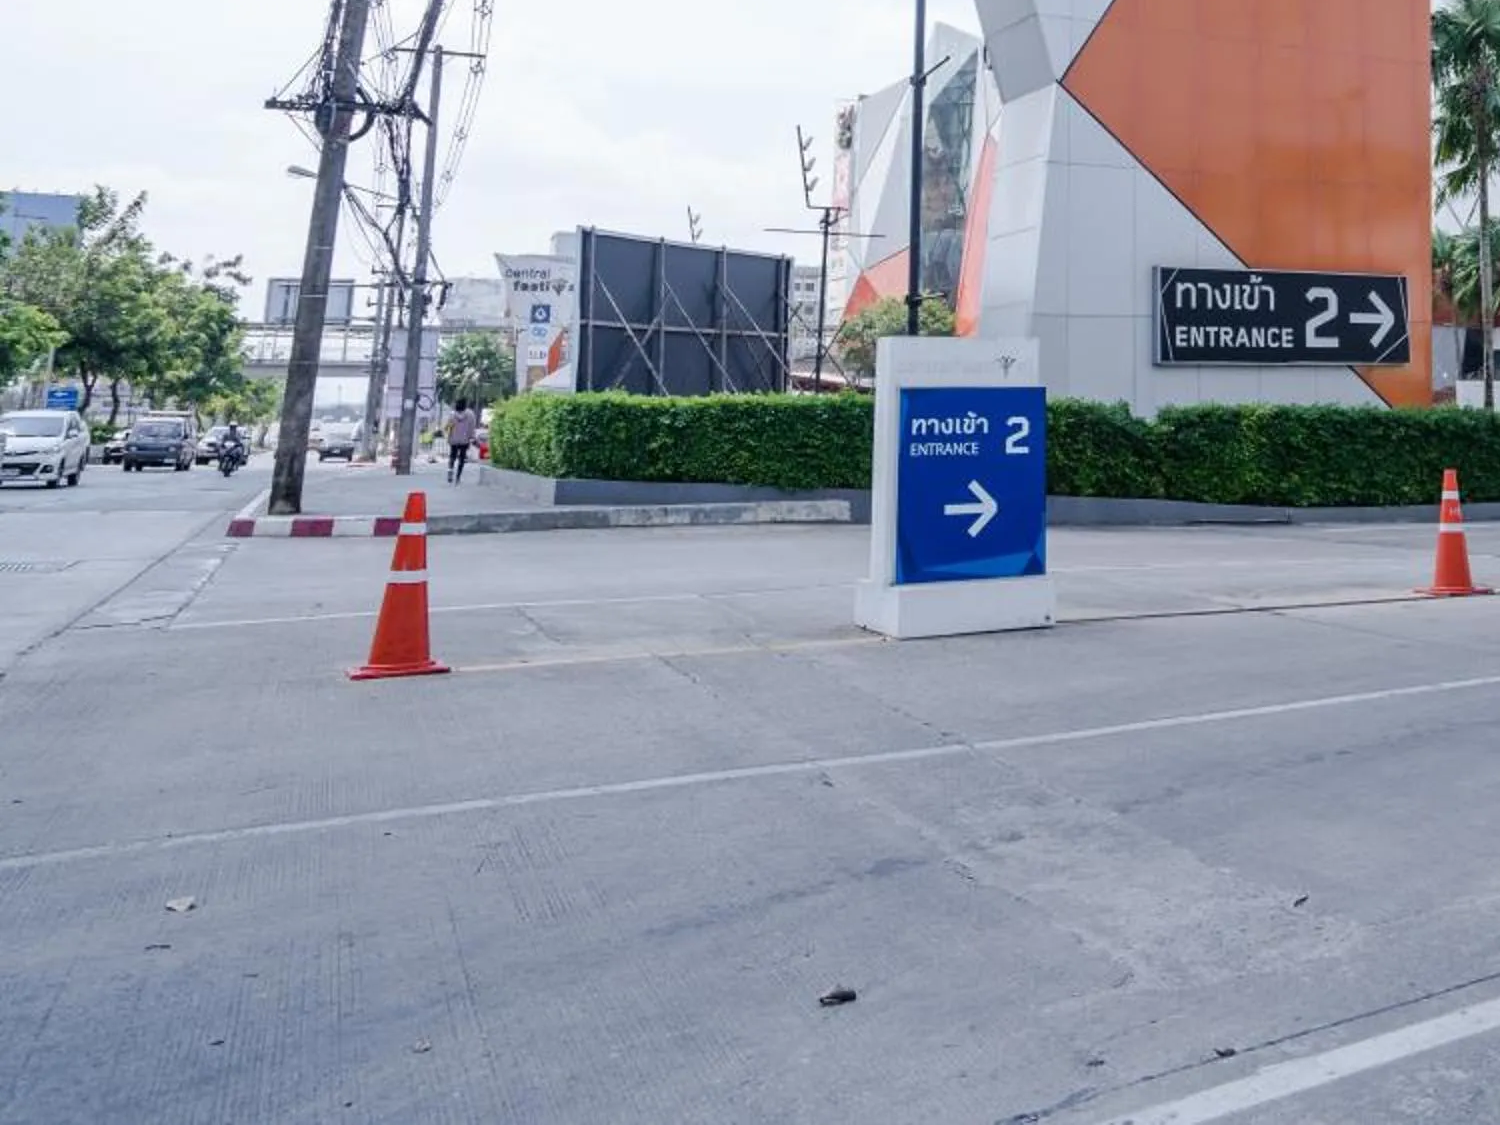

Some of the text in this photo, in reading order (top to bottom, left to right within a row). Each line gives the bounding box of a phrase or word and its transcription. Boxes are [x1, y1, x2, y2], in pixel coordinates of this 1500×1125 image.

[1175, 274, 1340, 348] ทางเข้า 2
[1175, 326, 1294, 348] ENTRANCE
[910, 442, 979, 457] ENTRANCE
[911, 411, 1030, 455] ทางเข้า 2
